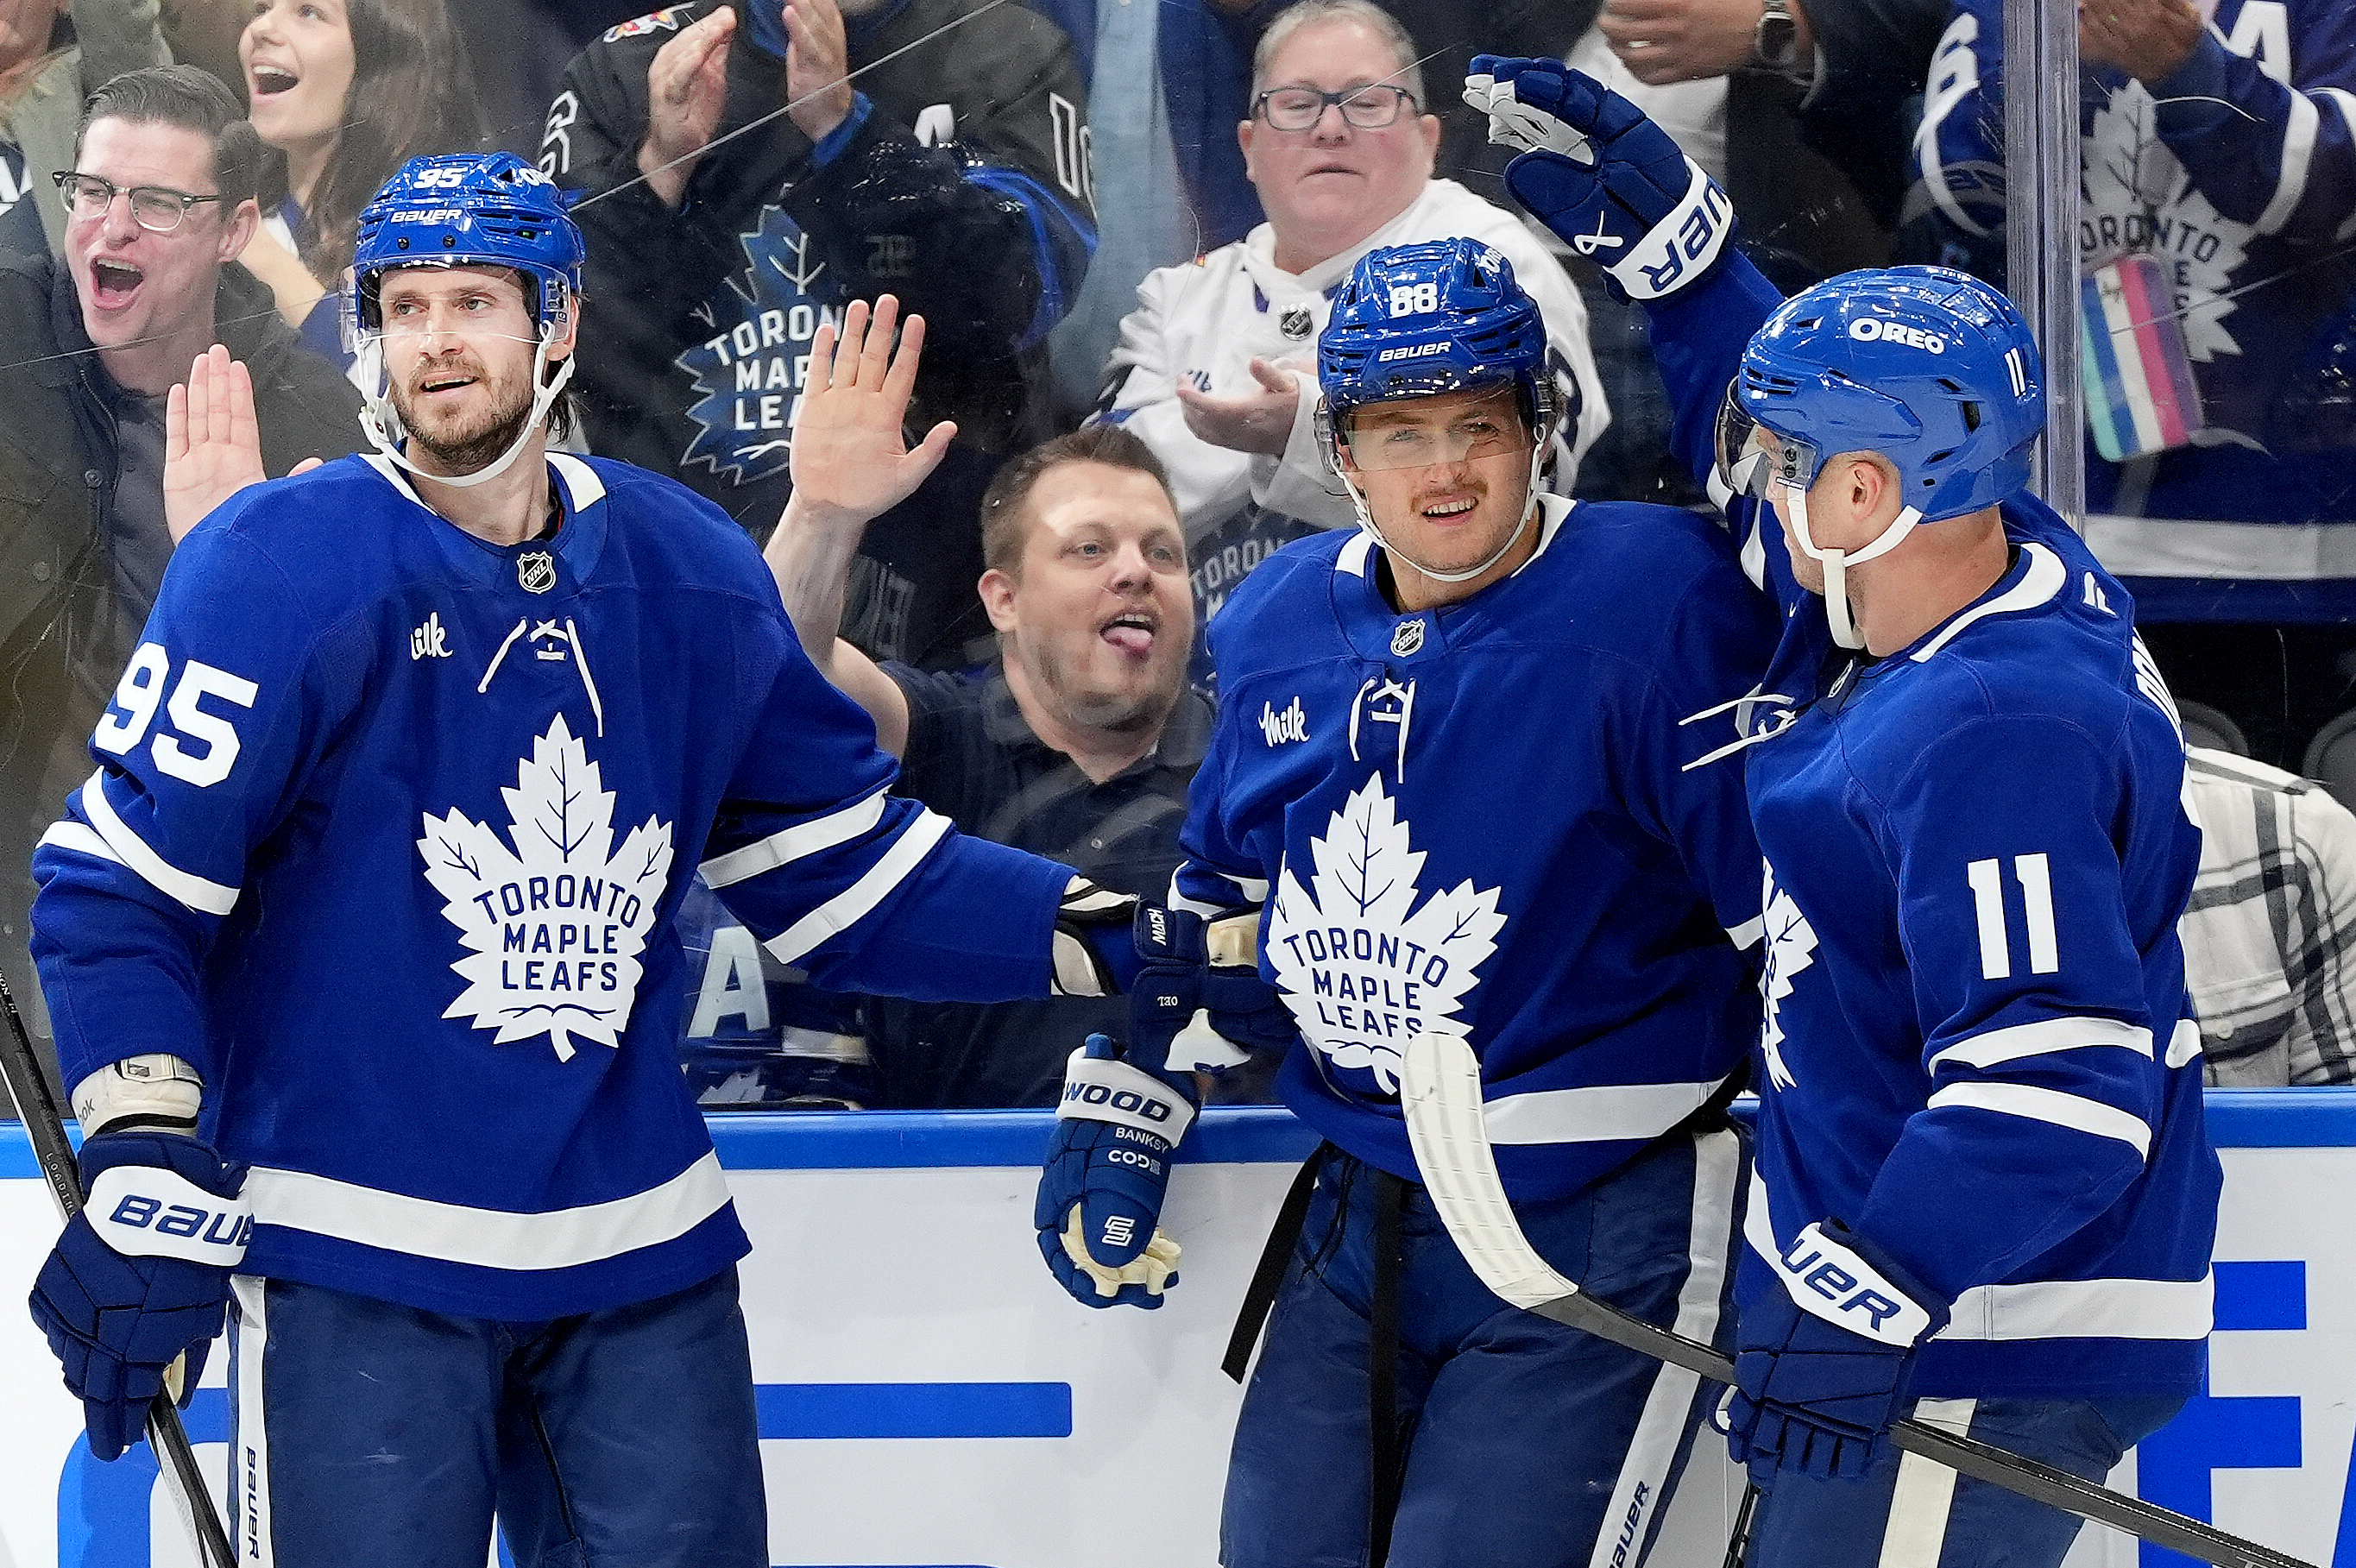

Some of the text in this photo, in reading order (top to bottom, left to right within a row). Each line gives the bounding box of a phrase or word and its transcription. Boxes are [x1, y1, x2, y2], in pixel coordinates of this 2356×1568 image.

[413, 167, 468, 188] 95
[1389, 282, 1438, 318] 88
[1849, 317, 1945, 355] OREO
[2004, 347, 2025, 397] 11
[526, 561, 548, 586] NHL
[95, 641, 260, 789] 95
[1258, 696, 1310, 747] Milk
[472, 874, 641, 929] TORONTO
[1968, 853, 2059, 979] 11
[502, 923, 620, 954] MAPLE
[1147, 908, 1167, 947] MACH
[501, 960, 618, 992] LEAFS
[1282, 927, 1449, 988] TORONTO
[687, 925, 771, 1038] A
[1156, 995, 1179, 1007] OEL
[1312, 967, 1421, 1011] MAPLE
[1115, 1126, 1169, 1155] BANKSY
